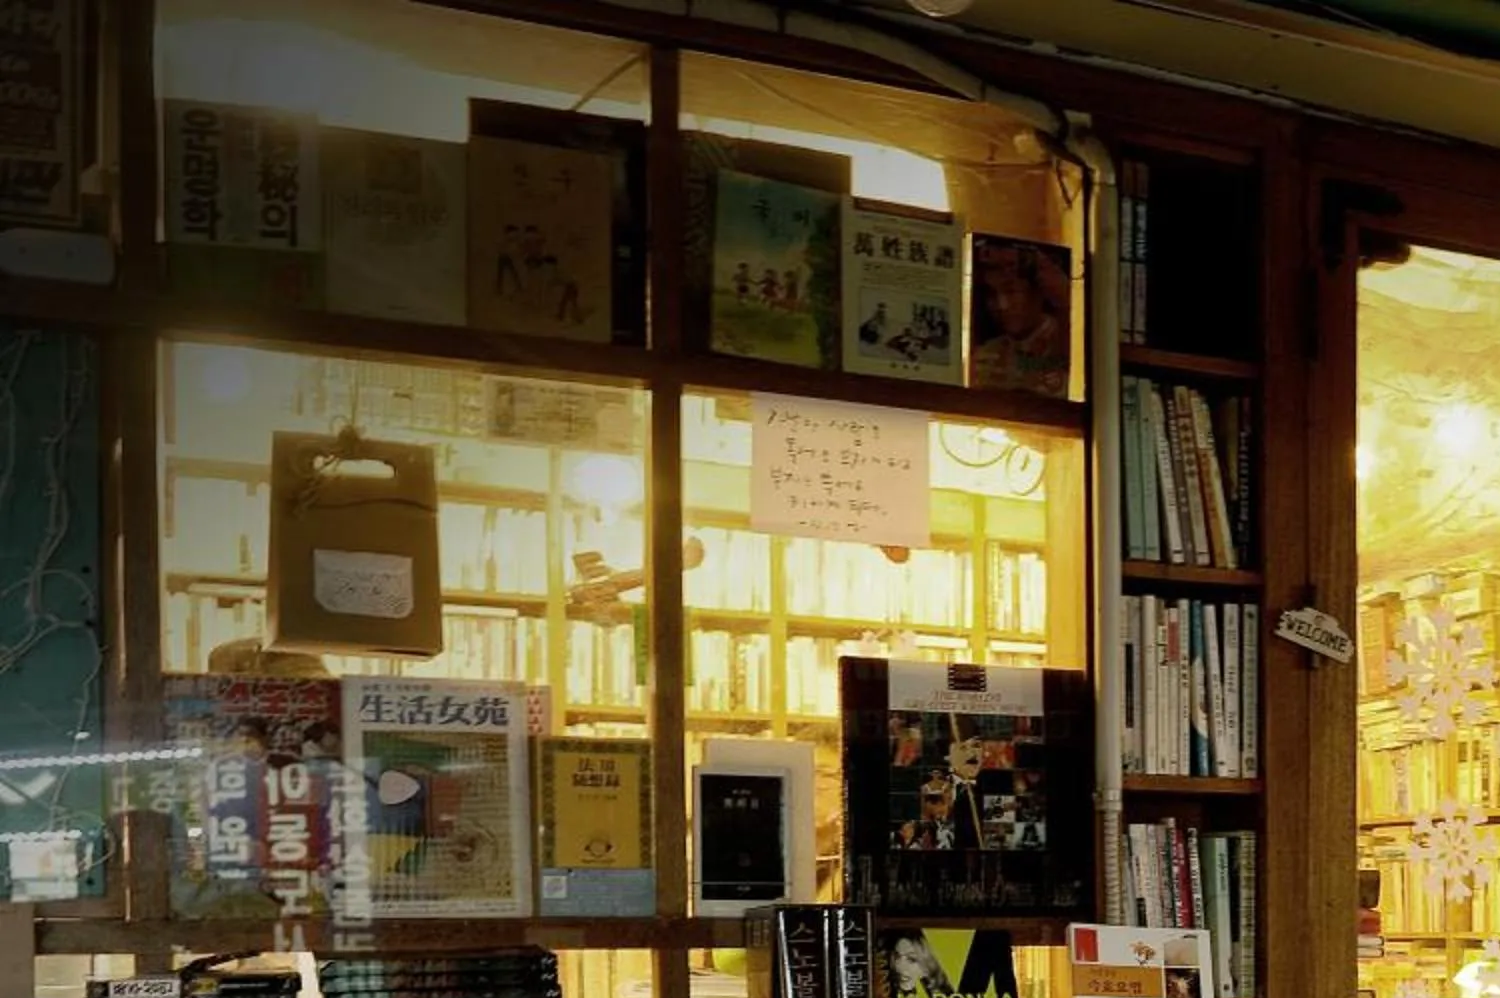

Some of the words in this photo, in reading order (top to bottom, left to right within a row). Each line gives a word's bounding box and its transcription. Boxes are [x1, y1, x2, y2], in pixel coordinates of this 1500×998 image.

[1281, 613, 1350, 657] WELCOME
[358, 693, 510, 727] 生活女苑
